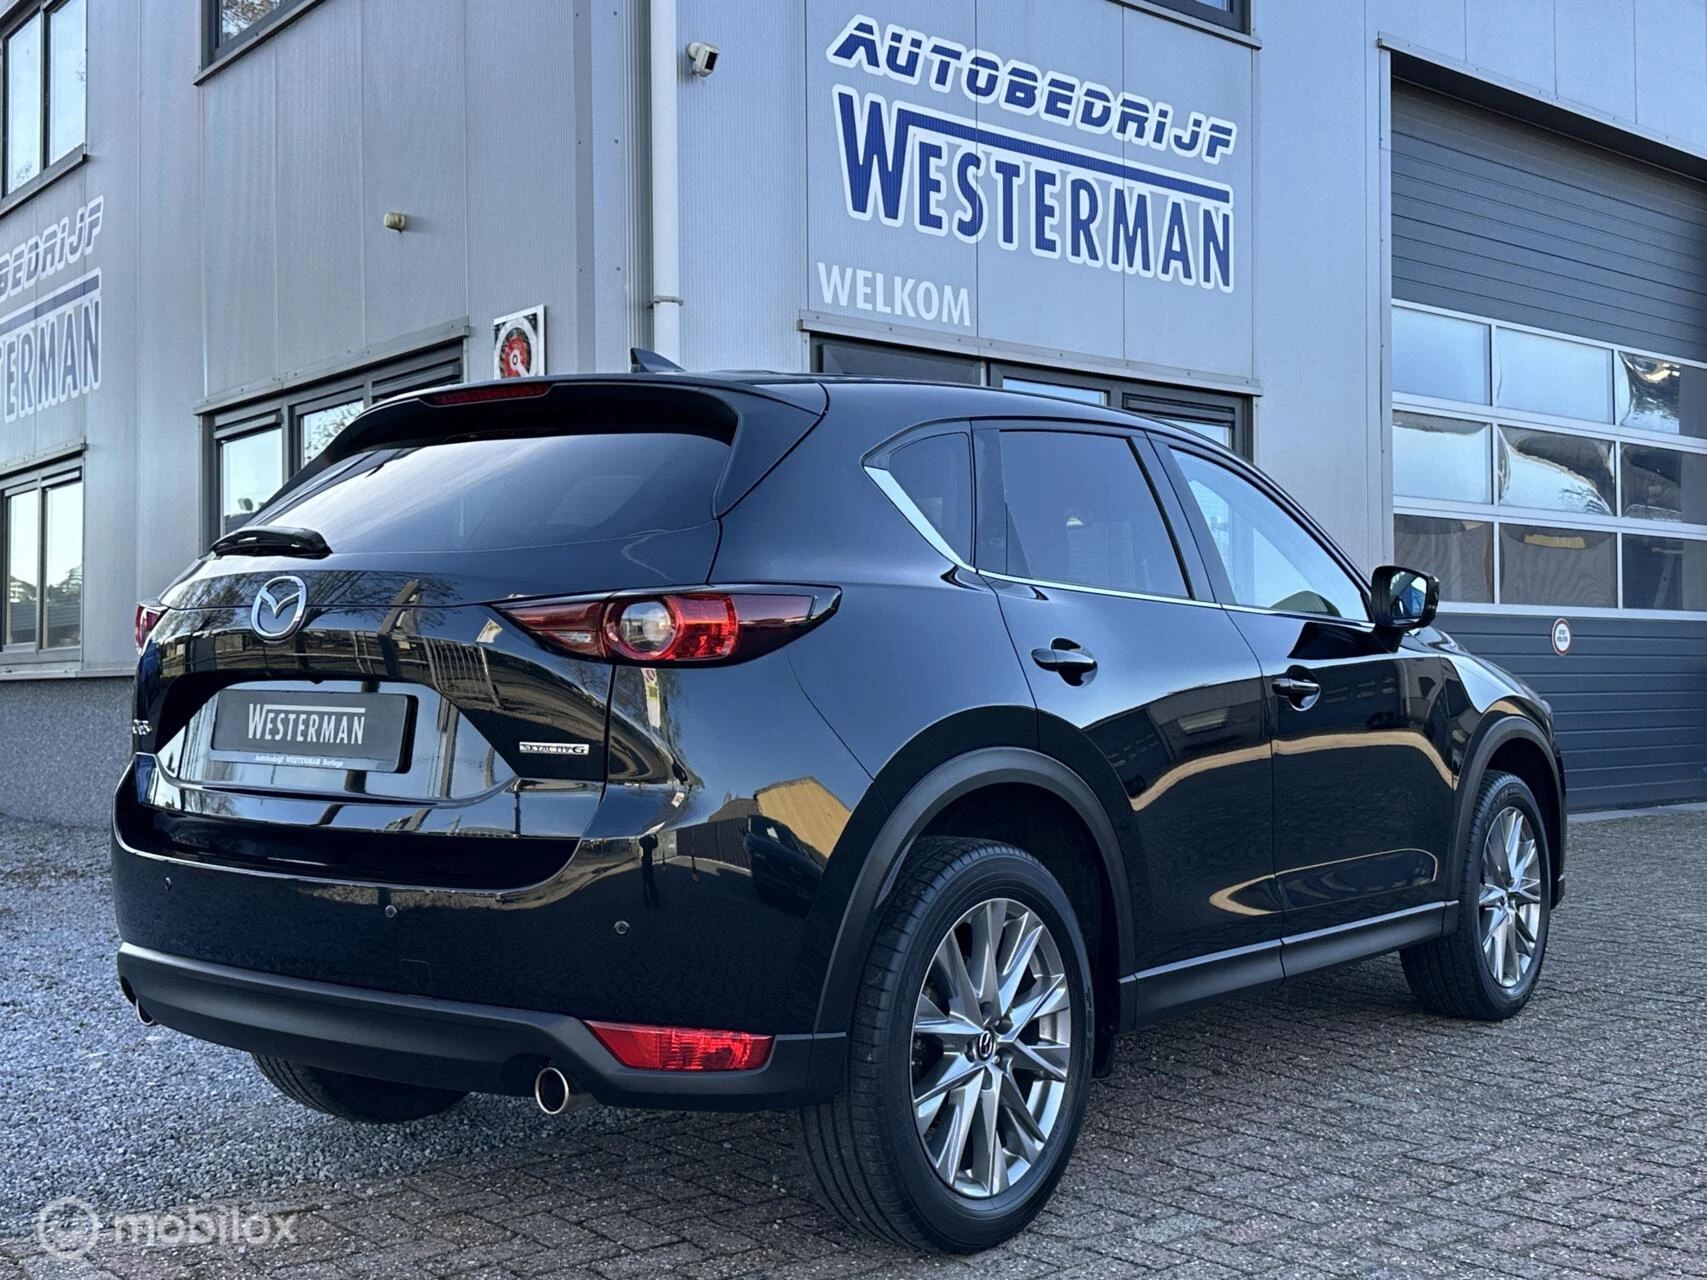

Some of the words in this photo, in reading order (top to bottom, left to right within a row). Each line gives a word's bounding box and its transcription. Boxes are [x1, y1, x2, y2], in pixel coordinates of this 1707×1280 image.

[829, 18, 1236, 161] AUTOBEDRIJF
[834, 88, 1233, 290] WESTERMAN
[817, 262, 971, 327] WELKOM
[248, 703, 366, 745] WESTERMAN
